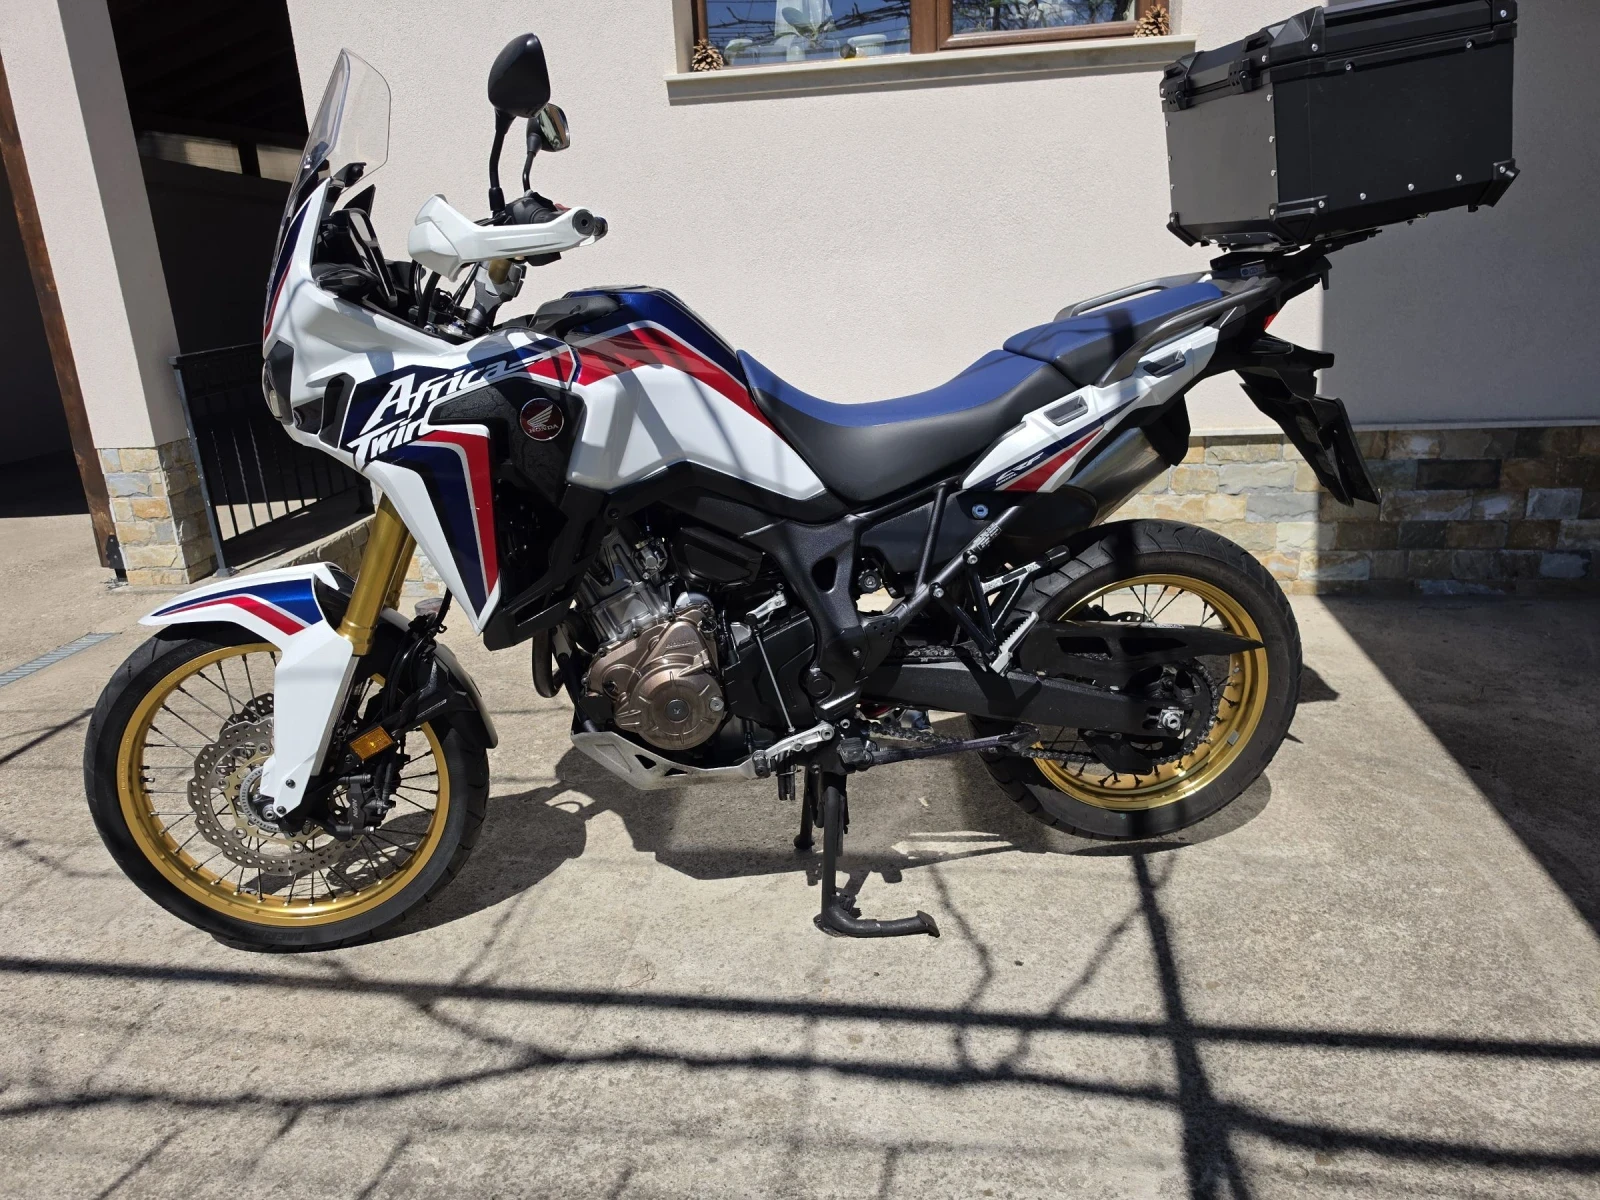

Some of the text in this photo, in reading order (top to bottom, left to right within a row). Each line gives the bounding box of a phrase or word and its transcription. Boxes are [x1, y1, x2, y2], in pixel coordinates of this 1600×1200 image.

[359, 359, 522, 436] Africa
[347, 416, 432, 471] Twin
[529, 424, 559, 434] HONDA
